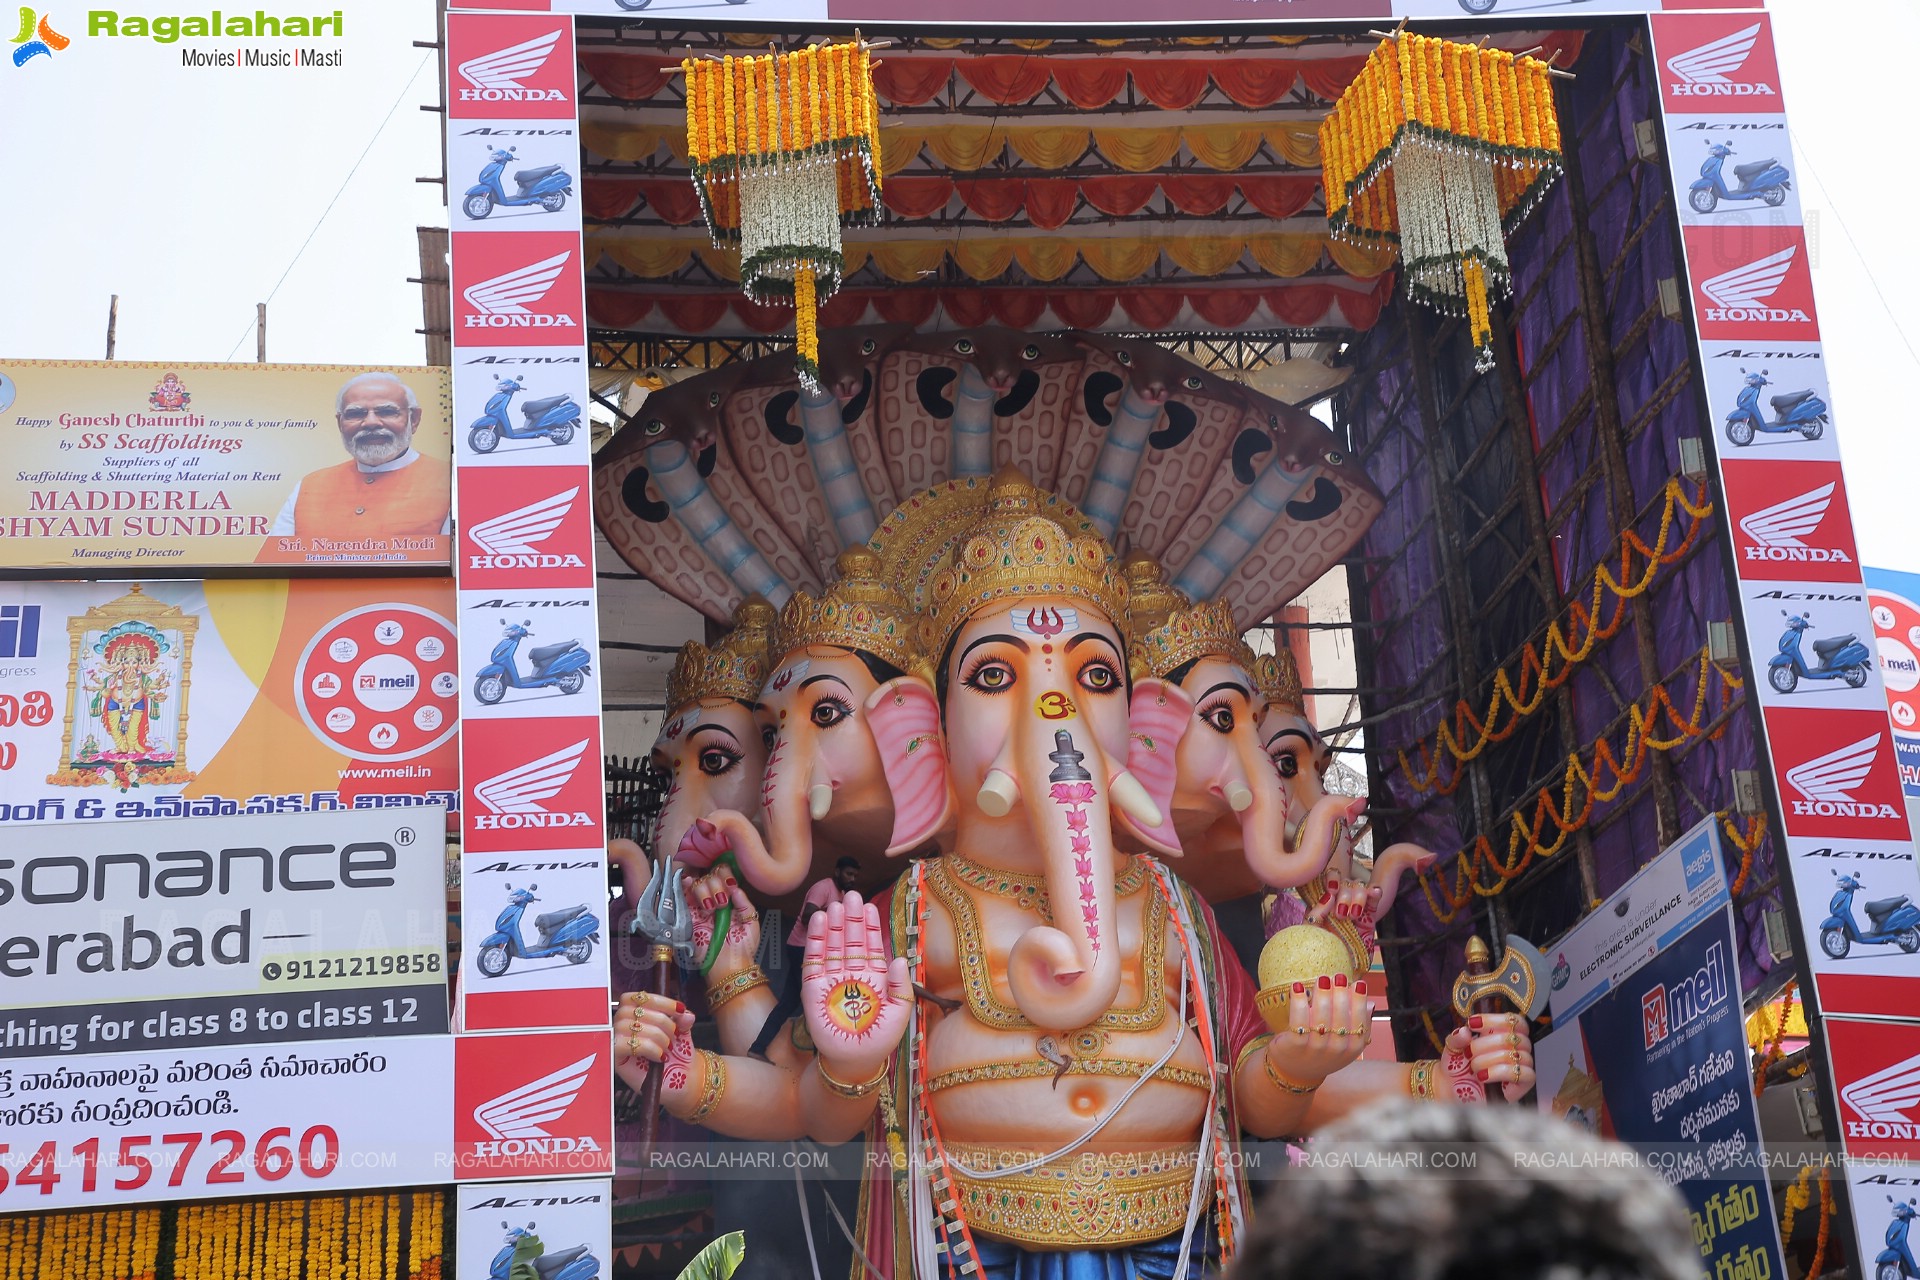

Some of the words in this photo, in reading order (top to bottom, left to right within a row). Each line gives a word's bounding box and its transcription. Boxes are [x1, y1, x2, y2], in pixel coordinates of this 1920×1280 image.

[459, 88, 568, 102] HONDA
[1671, 83, 1775, 96] HONDA
[458, 127, 572, 138] ACTIVA
[1676, 122, 1784, 131] ACTIVA
[464, 314, 577, 328] HONDA
[1706, 308, 1811, 322] HONDA
[463, 356, 580, 365] ACTIVA
[1711, 349, 1820, 359] ACTIVA
[15, 417, 52, 428] Happy
[59, 413, 121, 429] Ganesh
[125, 413, 205, 428] Chaturthi
[209, 419, 220, 428] to
[221, 420, 242, 430] you
[244, 419, 254, 427] &
[256, 420, 282, 430] your
[282, 418, 318, 430] family
[60, 440, 74, 451] by
[78, 433, 109, 449] SS
[114, 433, 243, 454] Scaffoldings
[103, 456, 160, 469] Suppliers
[164, 456, 179, 469] of
[182, 456, 200, 467] all
[16, 471, 88, 484] Scaffolding
[91, 471, 102, 481] &
[106, 471, 172, 484] Shuttering
[175, 471, 230, 482] Material
[232, 473, 248, 481] on
[251, 471, 281, 482] Rent
[28, 490, 232, 511] MADDERLA
[123, 516, 270, 537] SUNDER
[278, 538, 306, 551] Sri.
[312, 538, 388, 551] Narendra
[392, 537, 435, 550] Modi
[72, 548, 133, 560] Managing
[136, 547, 185, 558] Director
[306, 554, 332, 562] Prime
[1744, 546, 1852, 563] HONDA
[470, 555, 585, 569] HONDA
[1752, 590, 1861, 602] ACTIVA
[467, 599, 590, 610] ACTIVA
[1888, 658, 1916, 672] meil
[379, 675, 415, 688] meil
[338, 765, 432, 779] www.meil.in
[1792, 801, 1902, 819] HONDA
[475, 812, 596, 830] HONDA
[1801, 847, 1912, 861] ACTIVA
[471, 861, 599, 874] ACTIVA
[1685, 848, 1712, 877] aegis
[0, 842, 397, 906] onance
[1579, 940, 1624, 981] ELECTRONIC
[1624, 893, 1682, 945] SURVEILLANCE
[286, 953, 441, 981] 9121219858
[1669, 940, 1728, 1032] meil
[0, 1018, 79, 1051] hing
[87, 1014, 135, 1043] for
[142, 1010, 220, 1037] class
[229, 1007, 247, 1033] 8
[256, 1006, 288, 1031] to
[297, 1001, 372, 1028] class
[382, 997, 418, 1023] 12
[474, 1136, 601, 1158] HONDA
[0, 1124, 340, 1196] 4157260
[467, 1195, 600, 1211] ACTIVA
